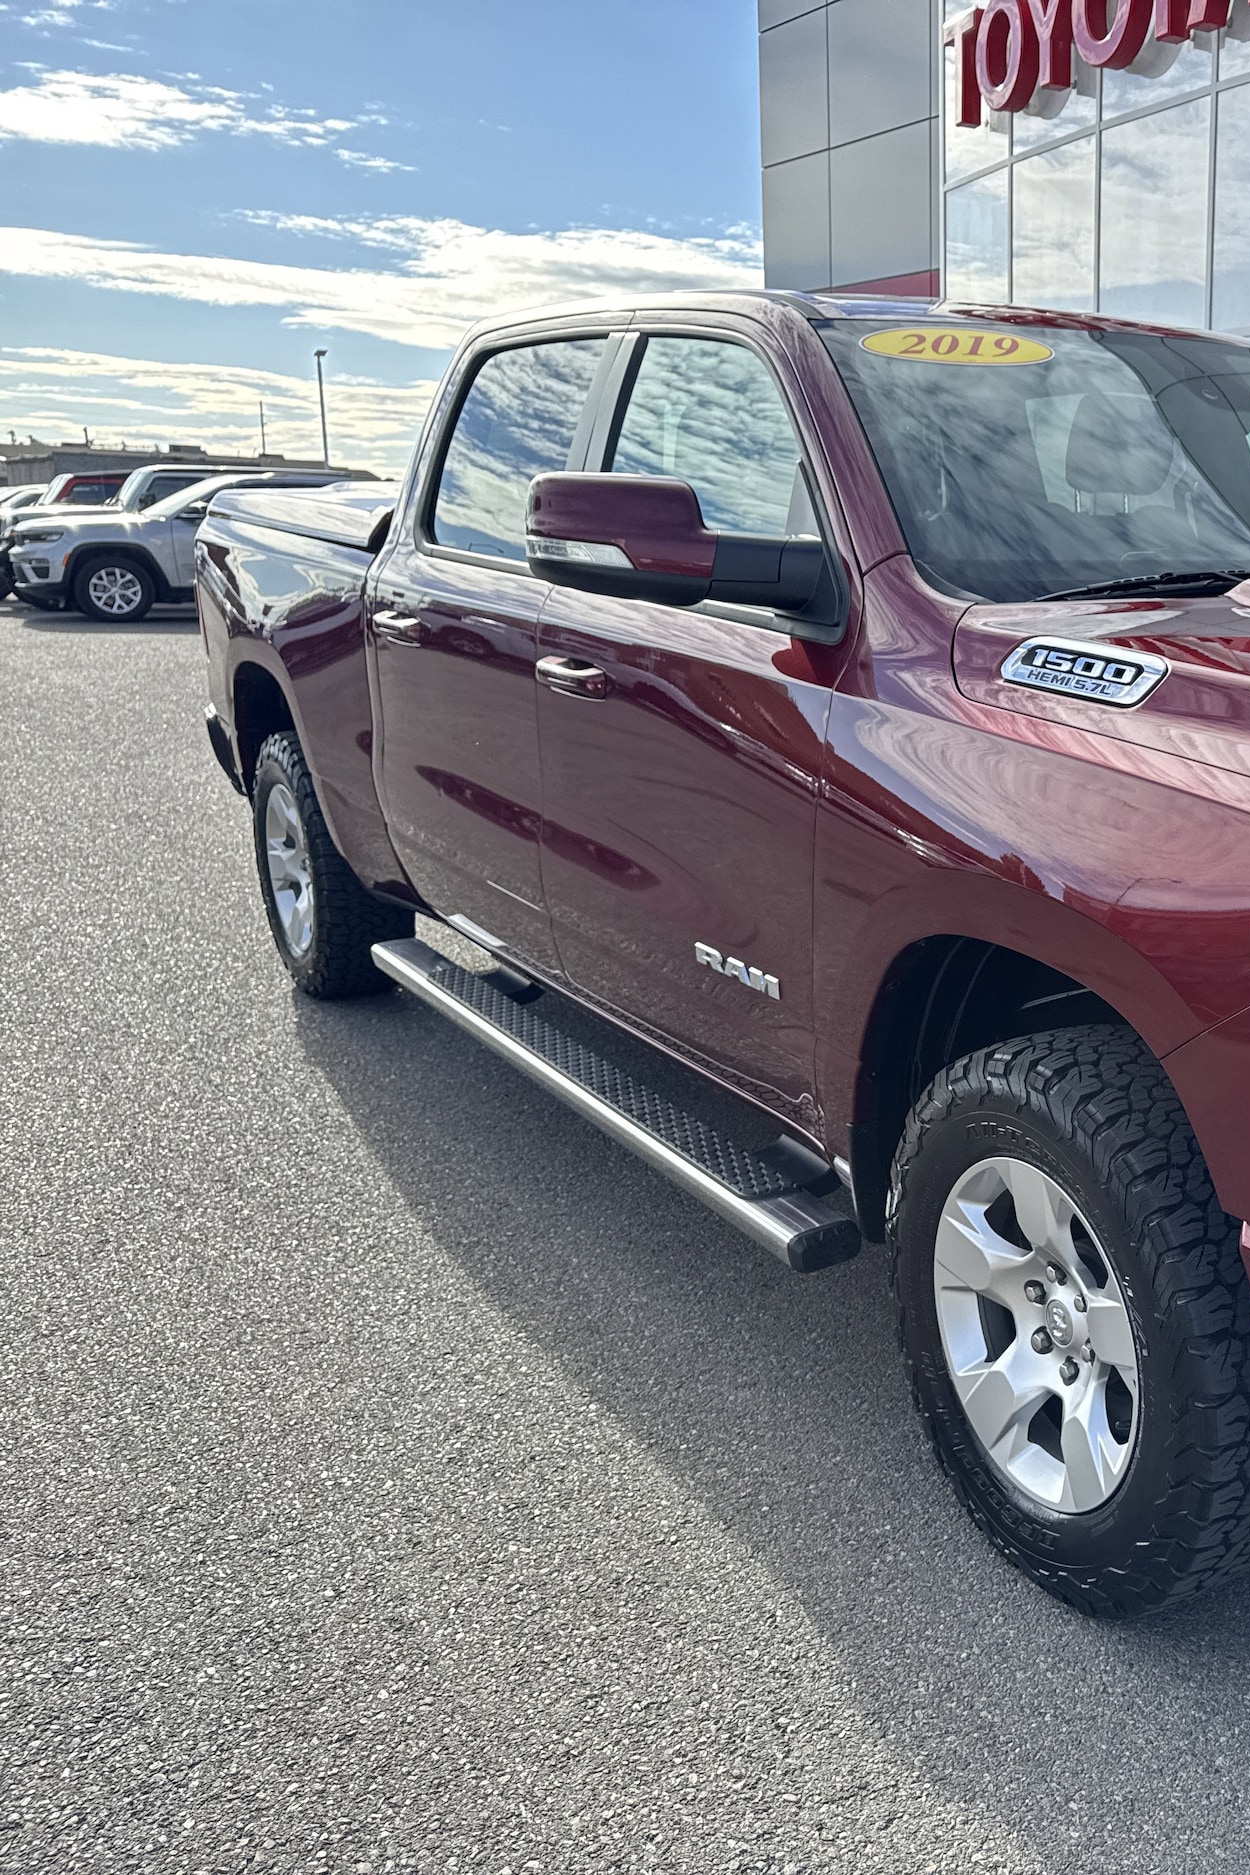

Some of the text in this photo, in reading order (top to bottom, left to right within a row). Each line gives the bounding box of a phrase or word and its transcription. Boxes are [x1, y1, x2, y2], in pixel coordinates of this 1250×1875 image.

[898, 333, 1019, 357] 2019
[1032, 648, 1137, 684] 1500
[1027, 669, 1113, 696] HEMI 5.7L
[694, 941, 780, 1000] RAM
